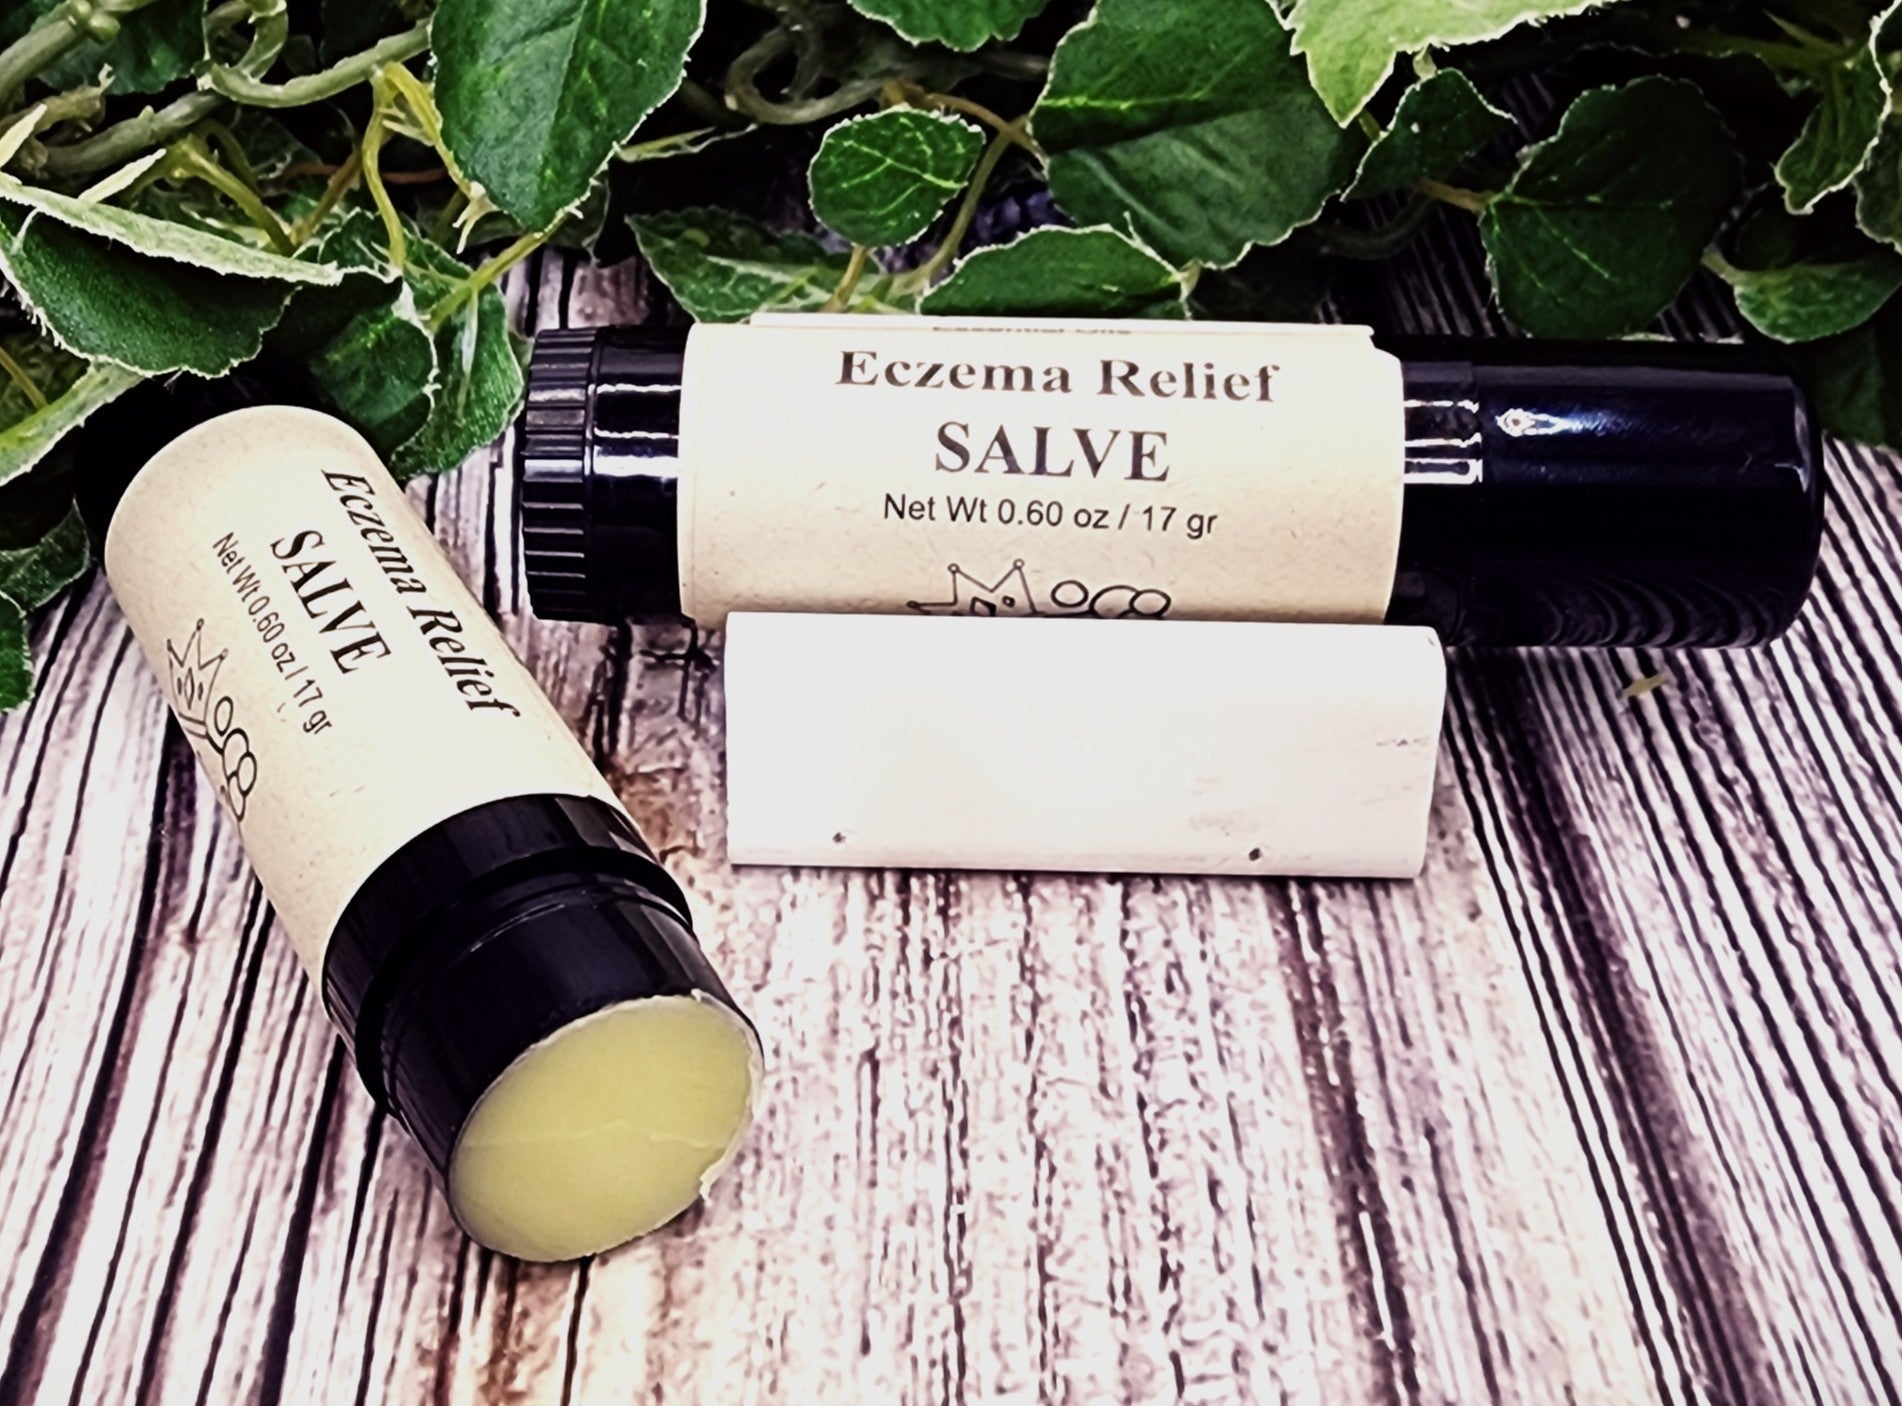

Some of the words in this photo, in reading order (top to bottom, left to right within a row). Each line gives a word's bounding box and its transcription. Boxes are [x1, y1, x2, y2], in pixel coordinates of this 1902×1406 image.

[835, 350, 1073, 393] Eczema
[1097, 358, 1281, 402] Relief
[935, 420, 1170, 482] SALVE
[884, 492, 936, 521] Net
[946, 495, 987, 523] Wt
[997, 498, 1063, 527] 0.60
[1073, 507, 1110, 530] oz
[1117, 503, 1131, 530] /
[1141, 505, 1177, 532] 17
[1186, 512, 1218, 540] gr
[212, 531, 246, 575] Net
[232, 564, 261, 603] Wt
[269, 529, 392, 675] SALVE
[320, 468, 427, 594] Eczema
[406, 605, 521, 718] Relief
[247, 595, 286, 643] 0.60
[271, 642, 296, 673] oz
[284, 665, 309, 681] /
[292, 678, 324, 708] 17
[302, 709, 333, 735] gr
